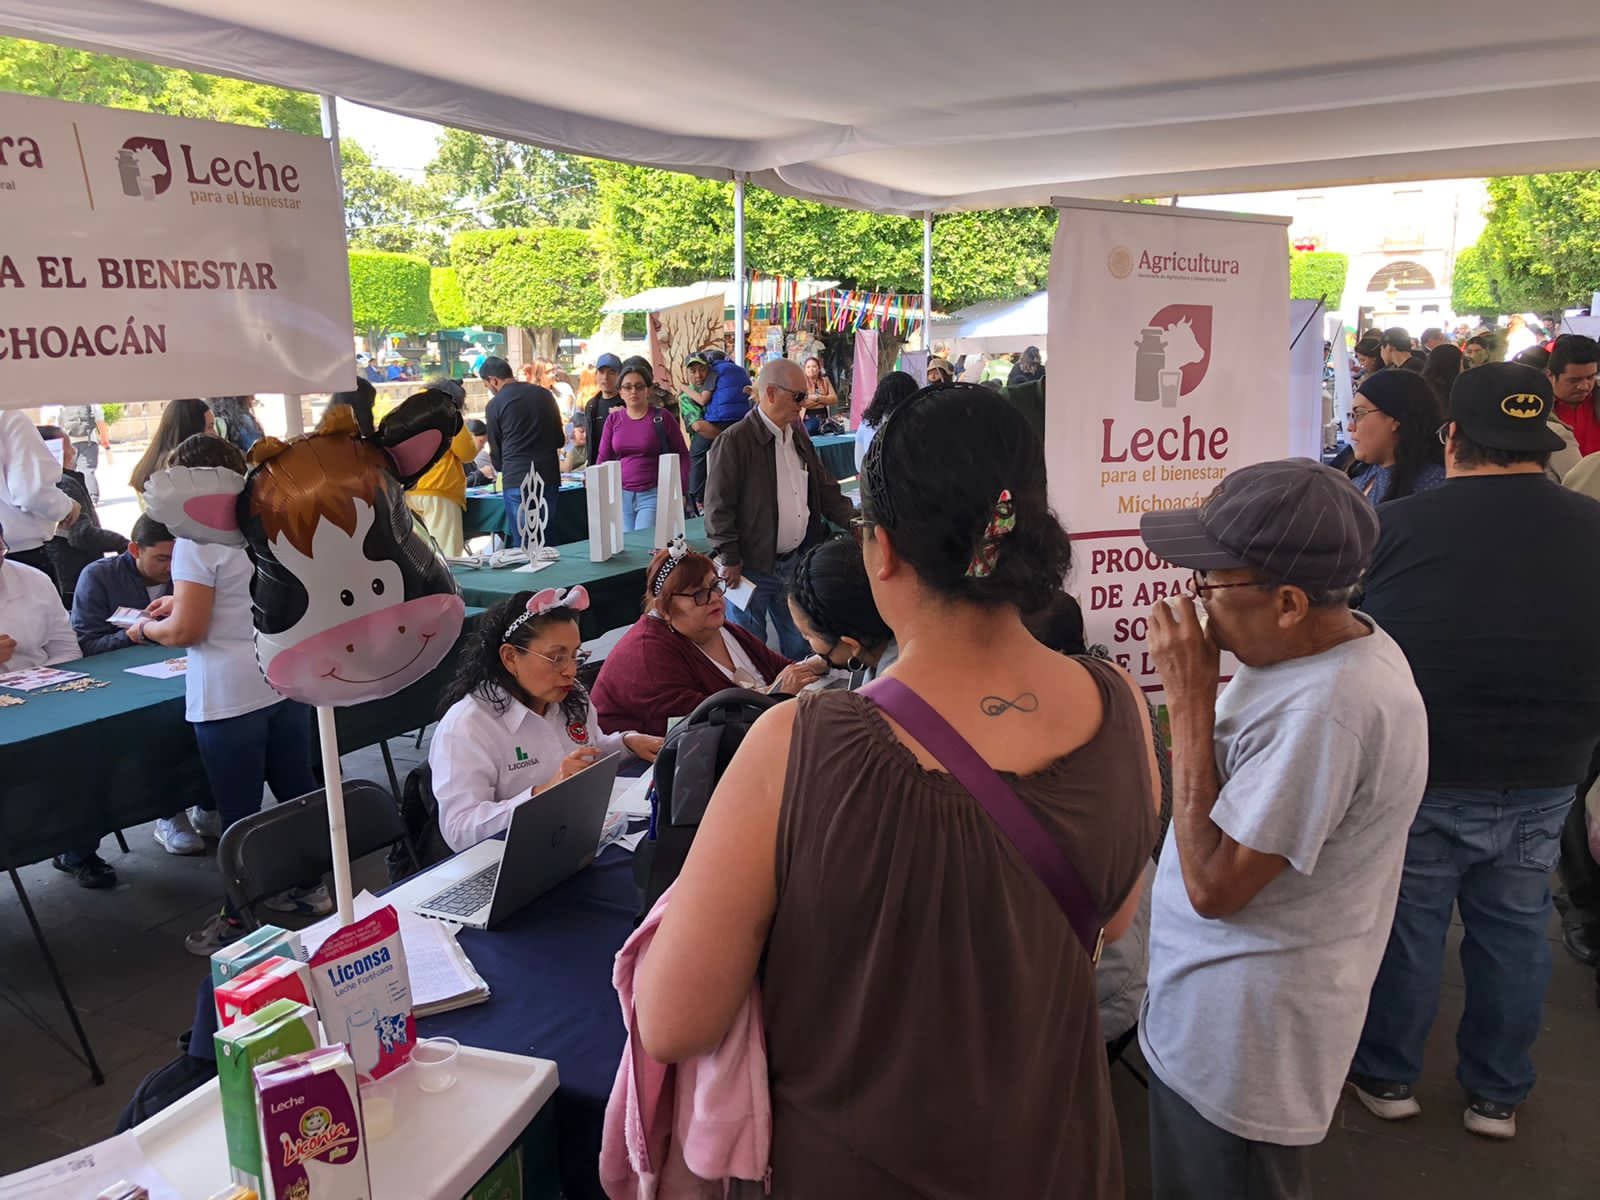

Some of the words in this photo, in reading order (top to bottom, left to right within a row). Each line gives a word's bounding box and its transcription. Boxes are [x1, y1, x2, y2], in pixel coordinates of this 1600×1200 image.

[181, 144, 300, 193] Leche
[190, 190, 223, 205] para
[226, 191, 239, 205] el
[242, 192, 302, 209] bienestar
[37, 256, 87, 288] EL
[98, 258, 278, 290] BIENESTAR
[1138, 249, 1240, 275] Agricultura
[1101, 415, 1229, 462] Leche
[1101, 470, 1137, 488] para
[1142, 466, 1156, 482] el
[1161, 465, 1227, 481] bienestar
[1091, 547, 1182, 575] PROG
[1091, 584, 1123, 610] DE
[328, 946, 391, 986] Liconsa
[271, 1096, 305, 1114] Leche
